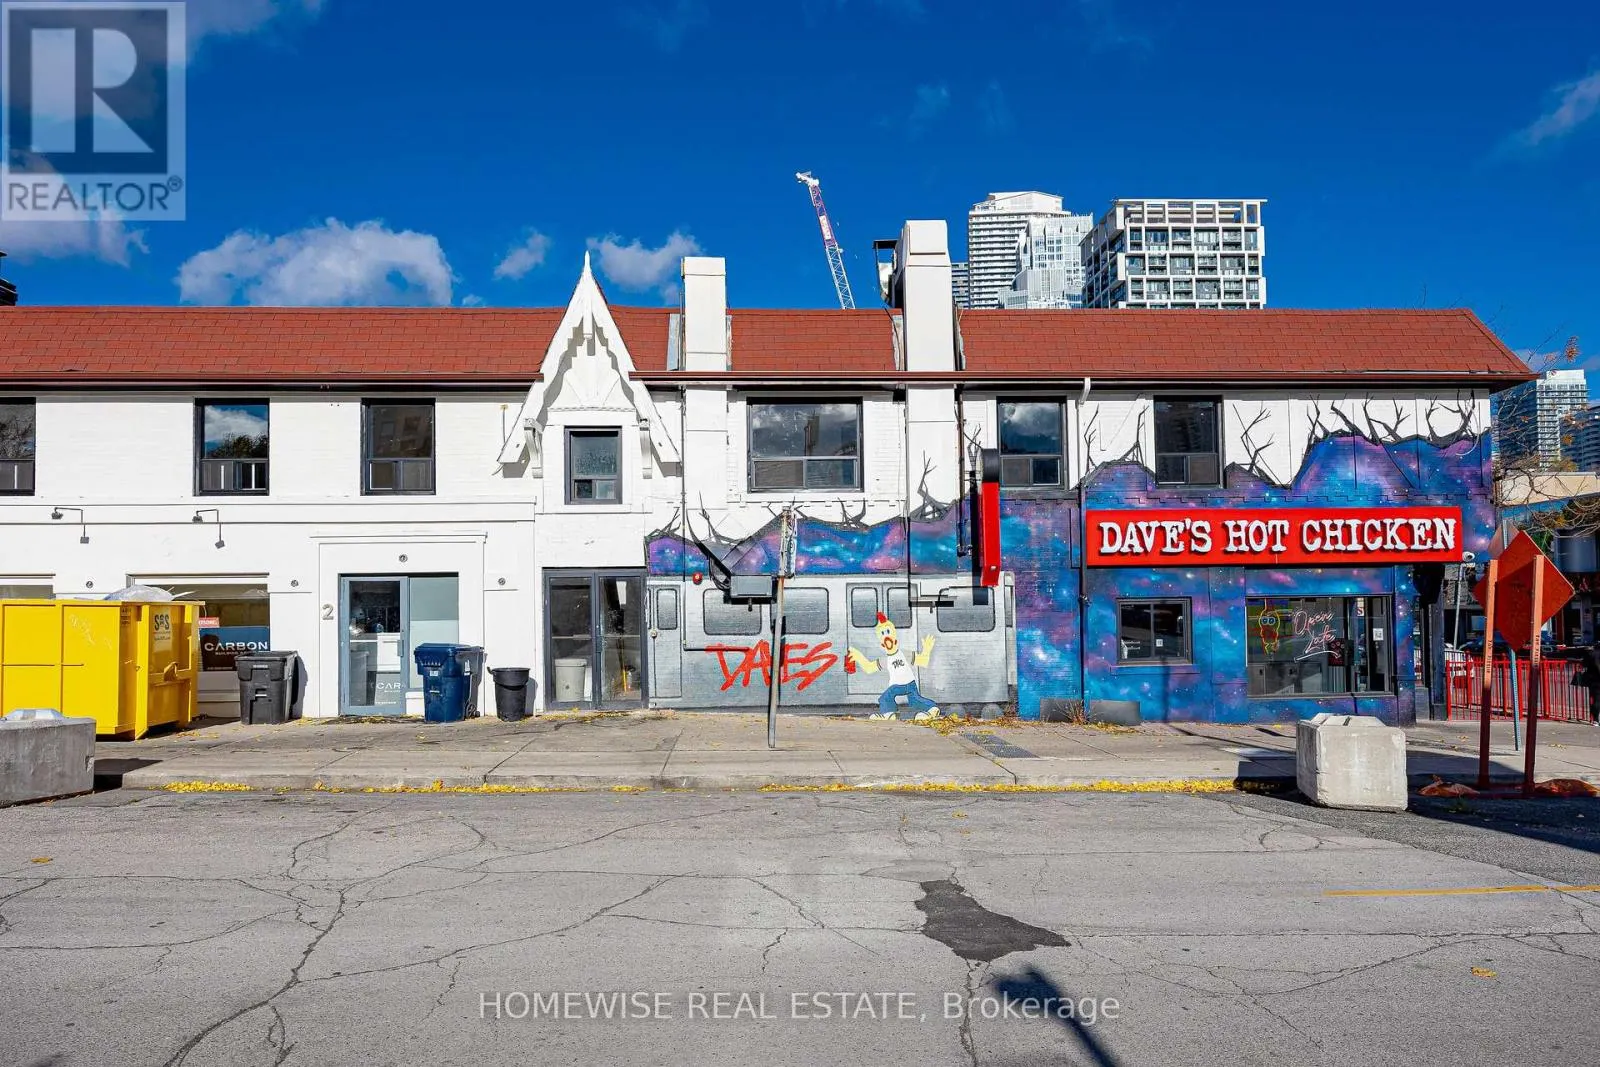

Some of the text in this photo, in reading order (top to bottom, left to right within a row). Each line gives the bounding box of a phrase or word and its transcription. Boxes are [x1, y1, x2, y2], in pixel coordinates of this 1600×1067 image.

[1099, 517, 1457, 555] DAVE'S HOT CHICKEN
[322, 603, 335, 621] 2
[204, 641, 269, 652] CARBON
[704, 639, 838, 691] DAES
